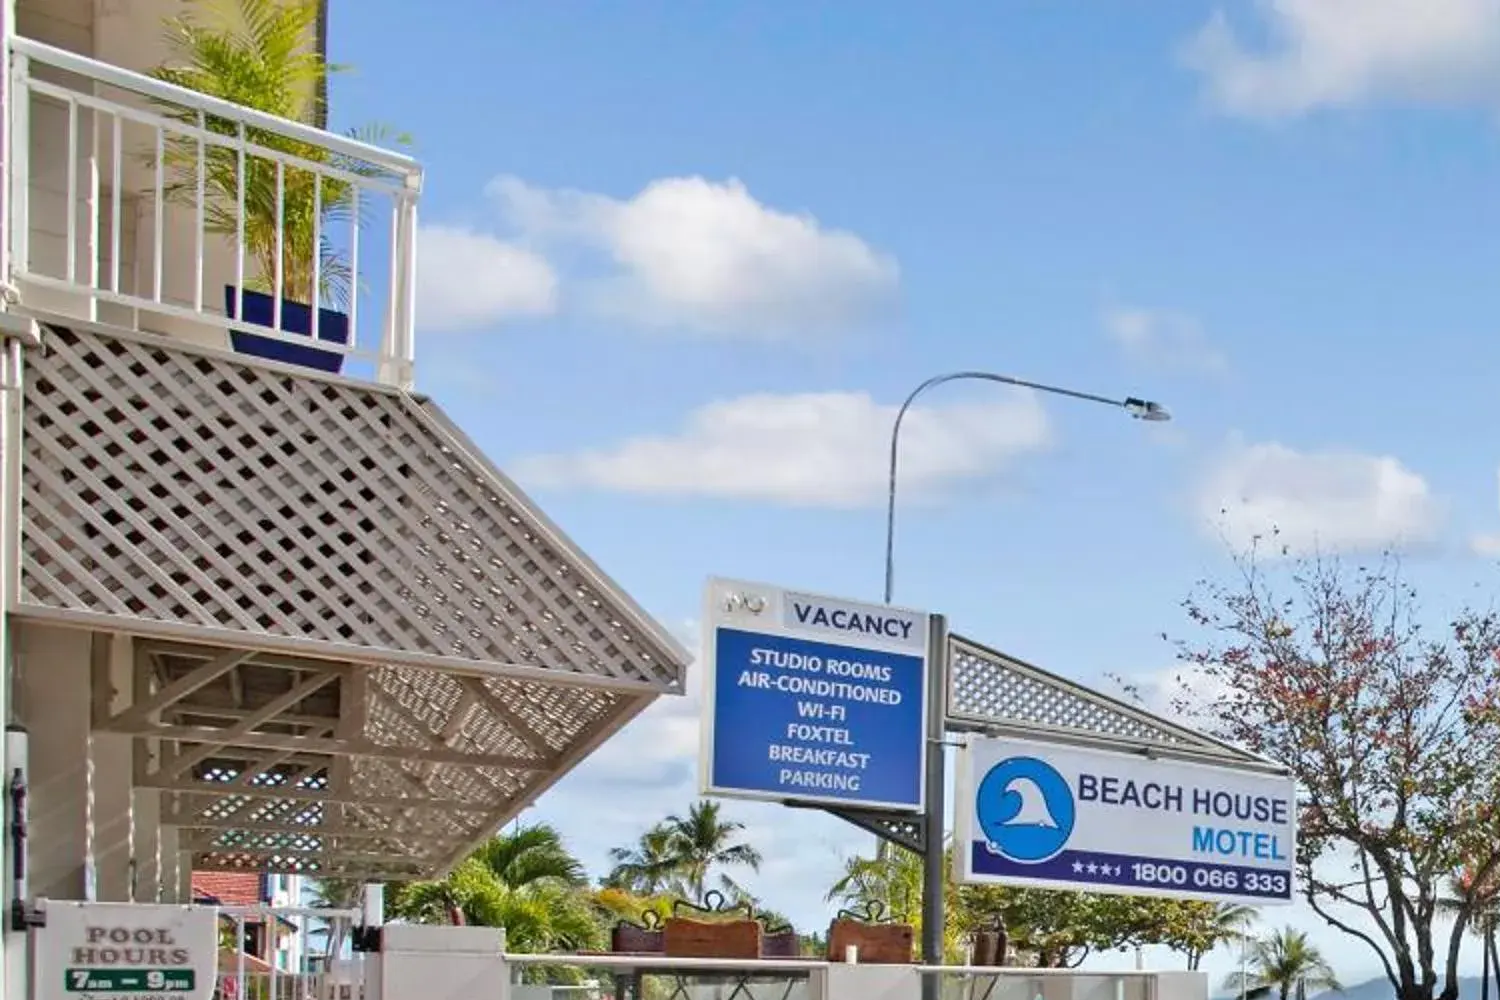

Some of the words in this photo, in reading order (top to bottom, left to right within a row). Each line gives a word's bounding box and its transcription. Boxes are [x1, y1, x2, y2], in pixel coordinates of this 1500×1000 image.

[794, 603, 913, 639] VACANCY
[751, 648, 821, 672] STUDIO
[827, 658, 892, 682] ROOMS
[737, 671, 902, 705] AIR-CONDITIONED
[797, 701, 846, 721] WI-FI
[787, 723, 854, 745] FOXTEL
[768, 745, 871, 769] BREAKFAST
[779, 769, 861, 791] PARKING
[1078, 774, 1183, 812] BEACH
[1192, 788, 1288, 824] HOUSE
[1192, 826, 1287, 860] MOTEL
[1131, 862, 1188, 886] 1800
[1194, 867, 1239, 889] 066
[1245, 871, 1287, 893] 333
[87, 927, 176, 944] POOL
[71, 948, 189, 965] HOURS
[72, 971, 113, 988] 7am
[147, 971, 189, 991] 9pm
